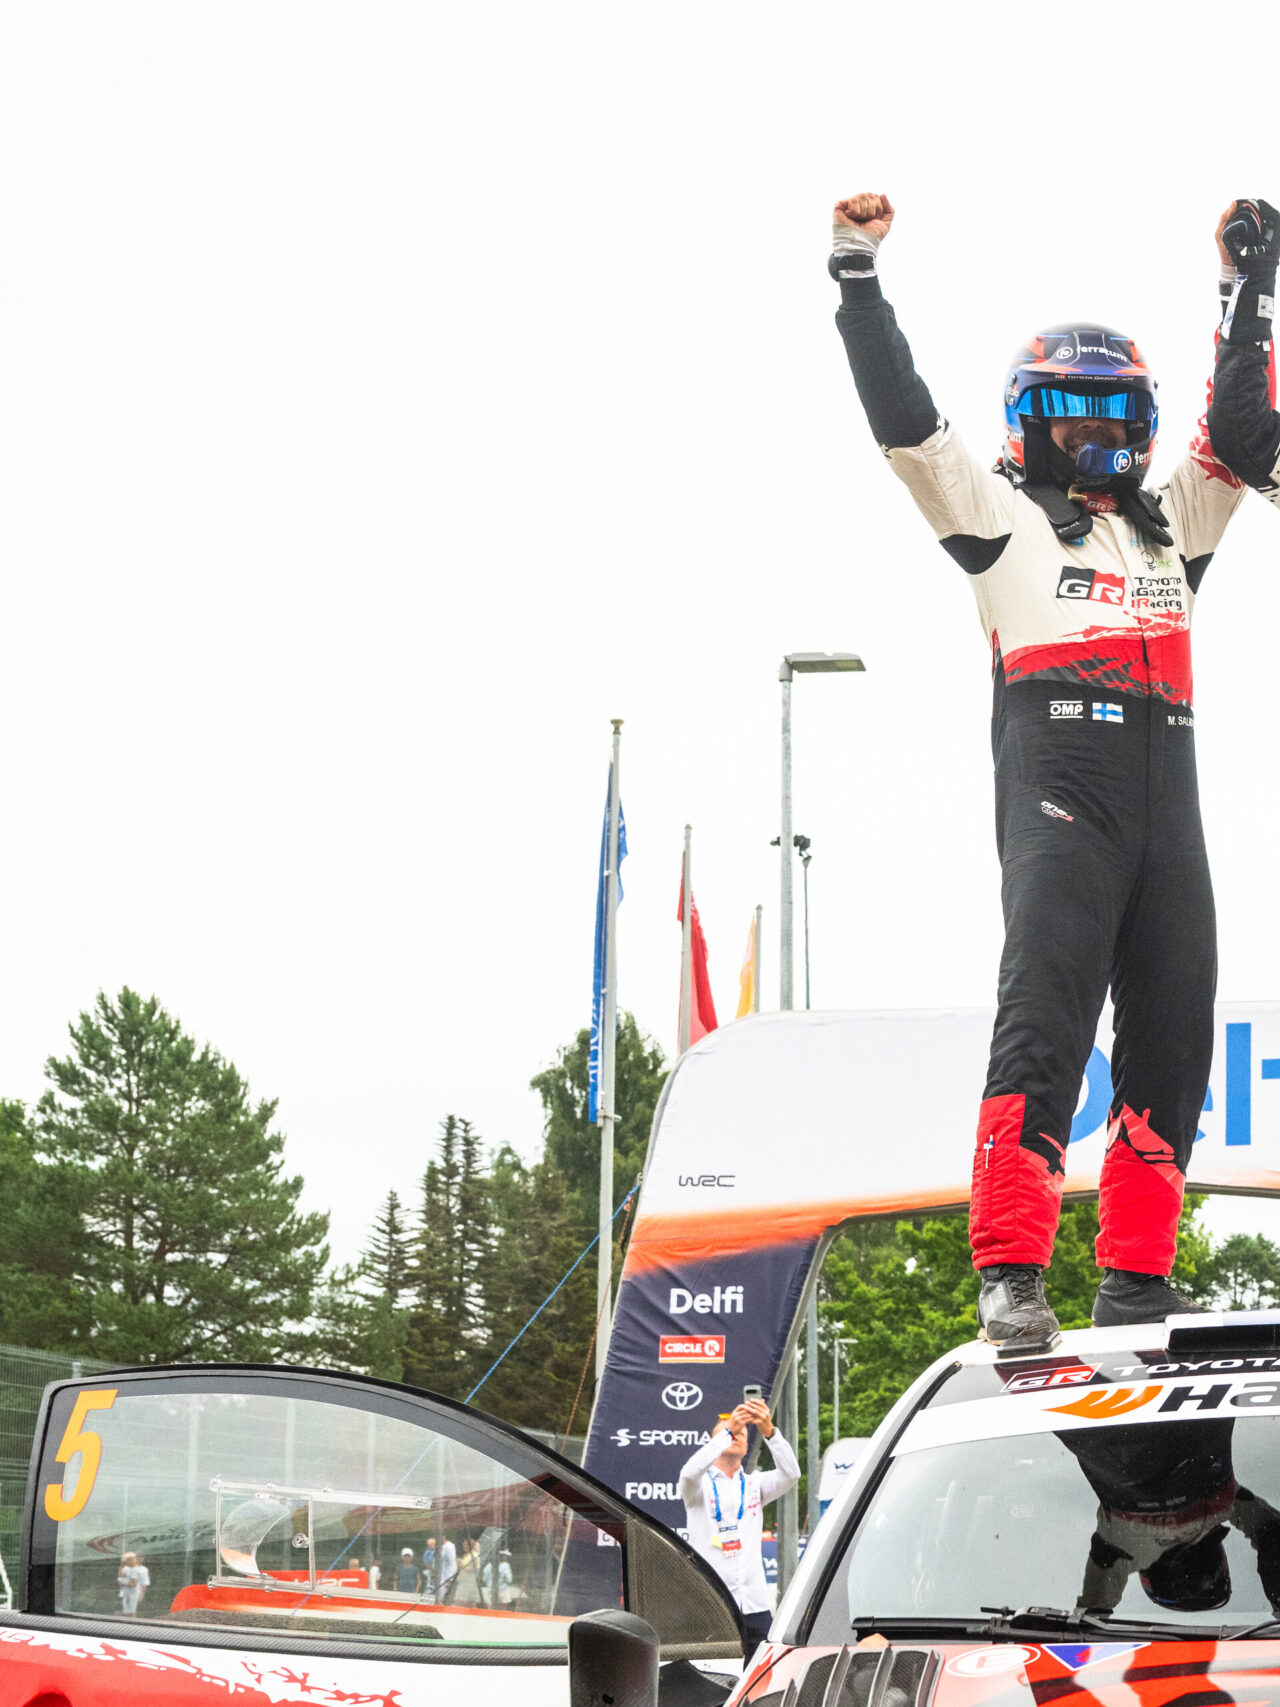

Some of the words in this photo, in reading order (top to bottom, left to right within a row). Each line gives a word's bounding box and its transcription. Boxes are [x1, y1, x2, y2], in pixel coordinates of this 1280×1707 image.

[1058, 578, 1123, 605] GR
[1050, 703, 1084, 715] OMP
[1167, 715, 1176, 726] M.
[679, 1175, 736, 1188] WRC
[669, 1285, 744, 1315] Delfi
[664, 1342, 703, 1354] CIRCLE
[1008, 1366, 1098, 1390] GR
[44, 1389, 119, 1522] 5
